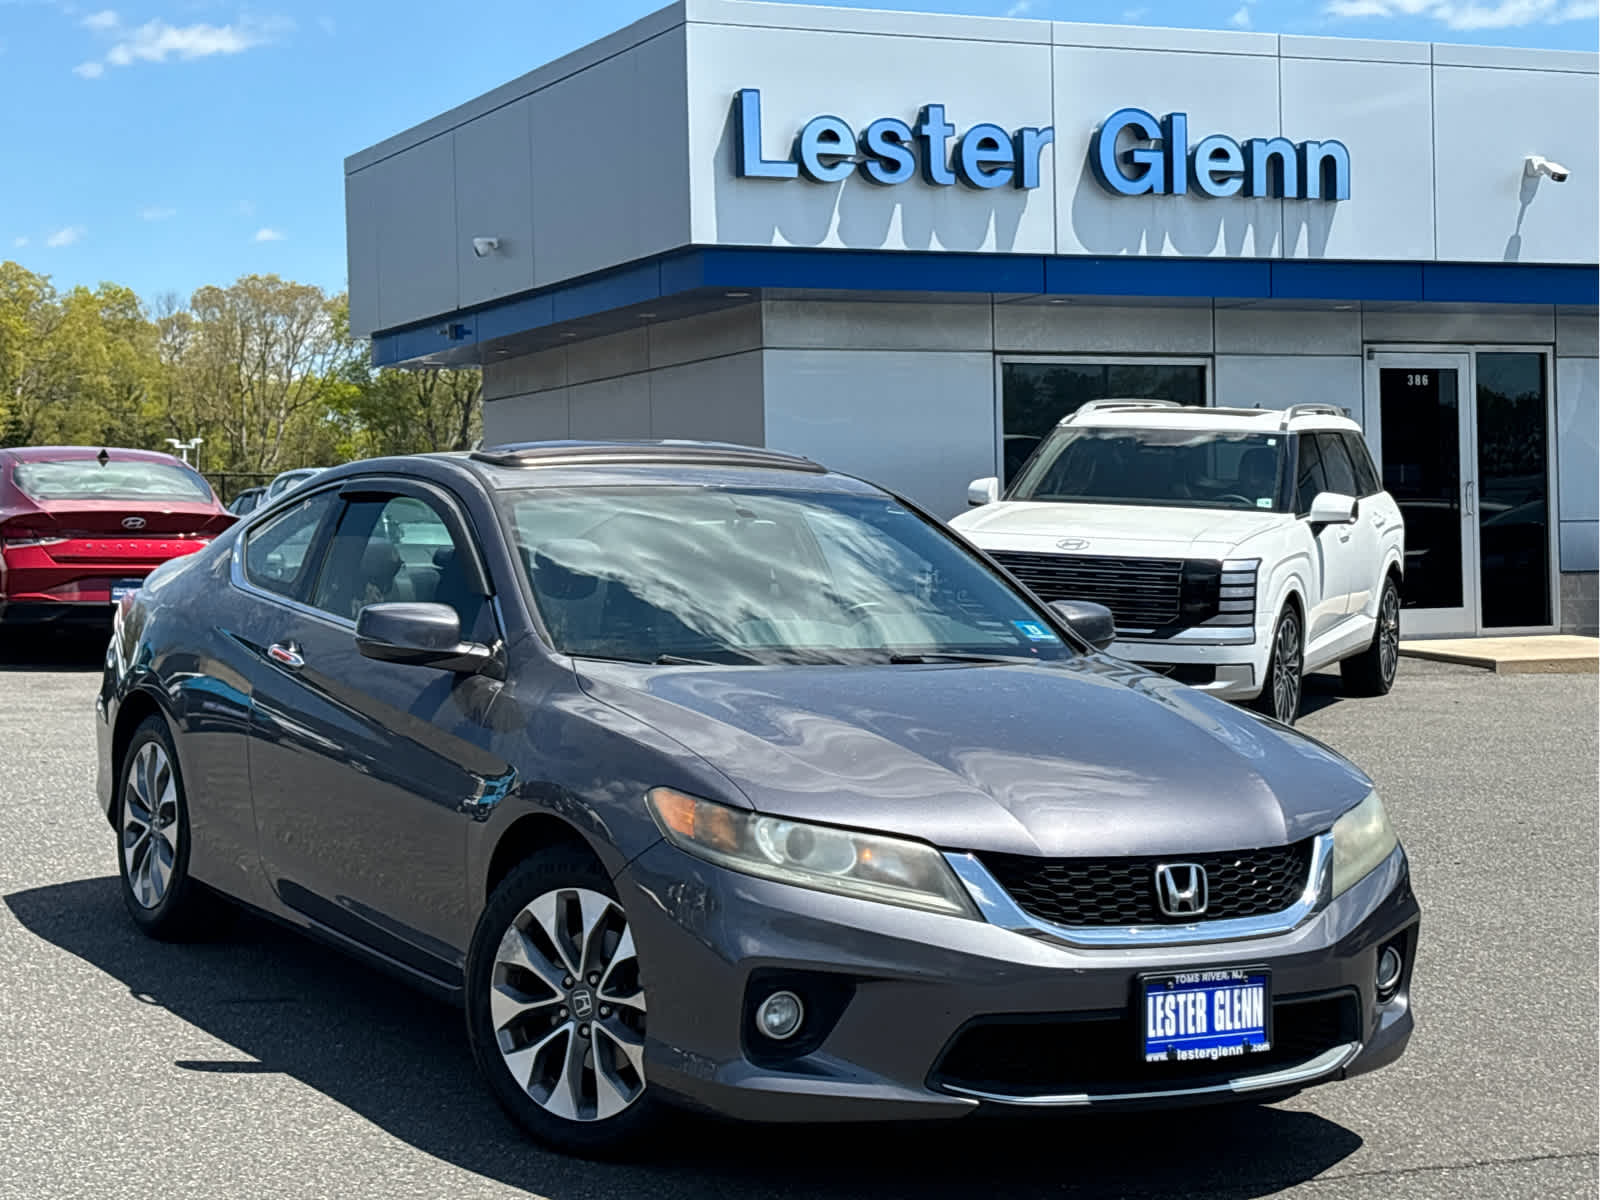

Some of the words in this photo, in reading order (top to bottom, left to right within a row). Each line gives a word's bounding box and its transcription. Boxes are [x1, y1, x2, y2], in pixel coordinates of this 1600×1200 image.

[735, 88, 1055, 190] Lester
[1094, 107, 1351, 201] Glenn
[1407, 374, 1429, 386] 386
[1175, 974, 1199, 985] TOMS
[1147, 992, 1207, 1038] LESTER
[1214, 987, 1264, 1031] GLENN
[1176, 1046, 1243, 1061] lesterglenn
